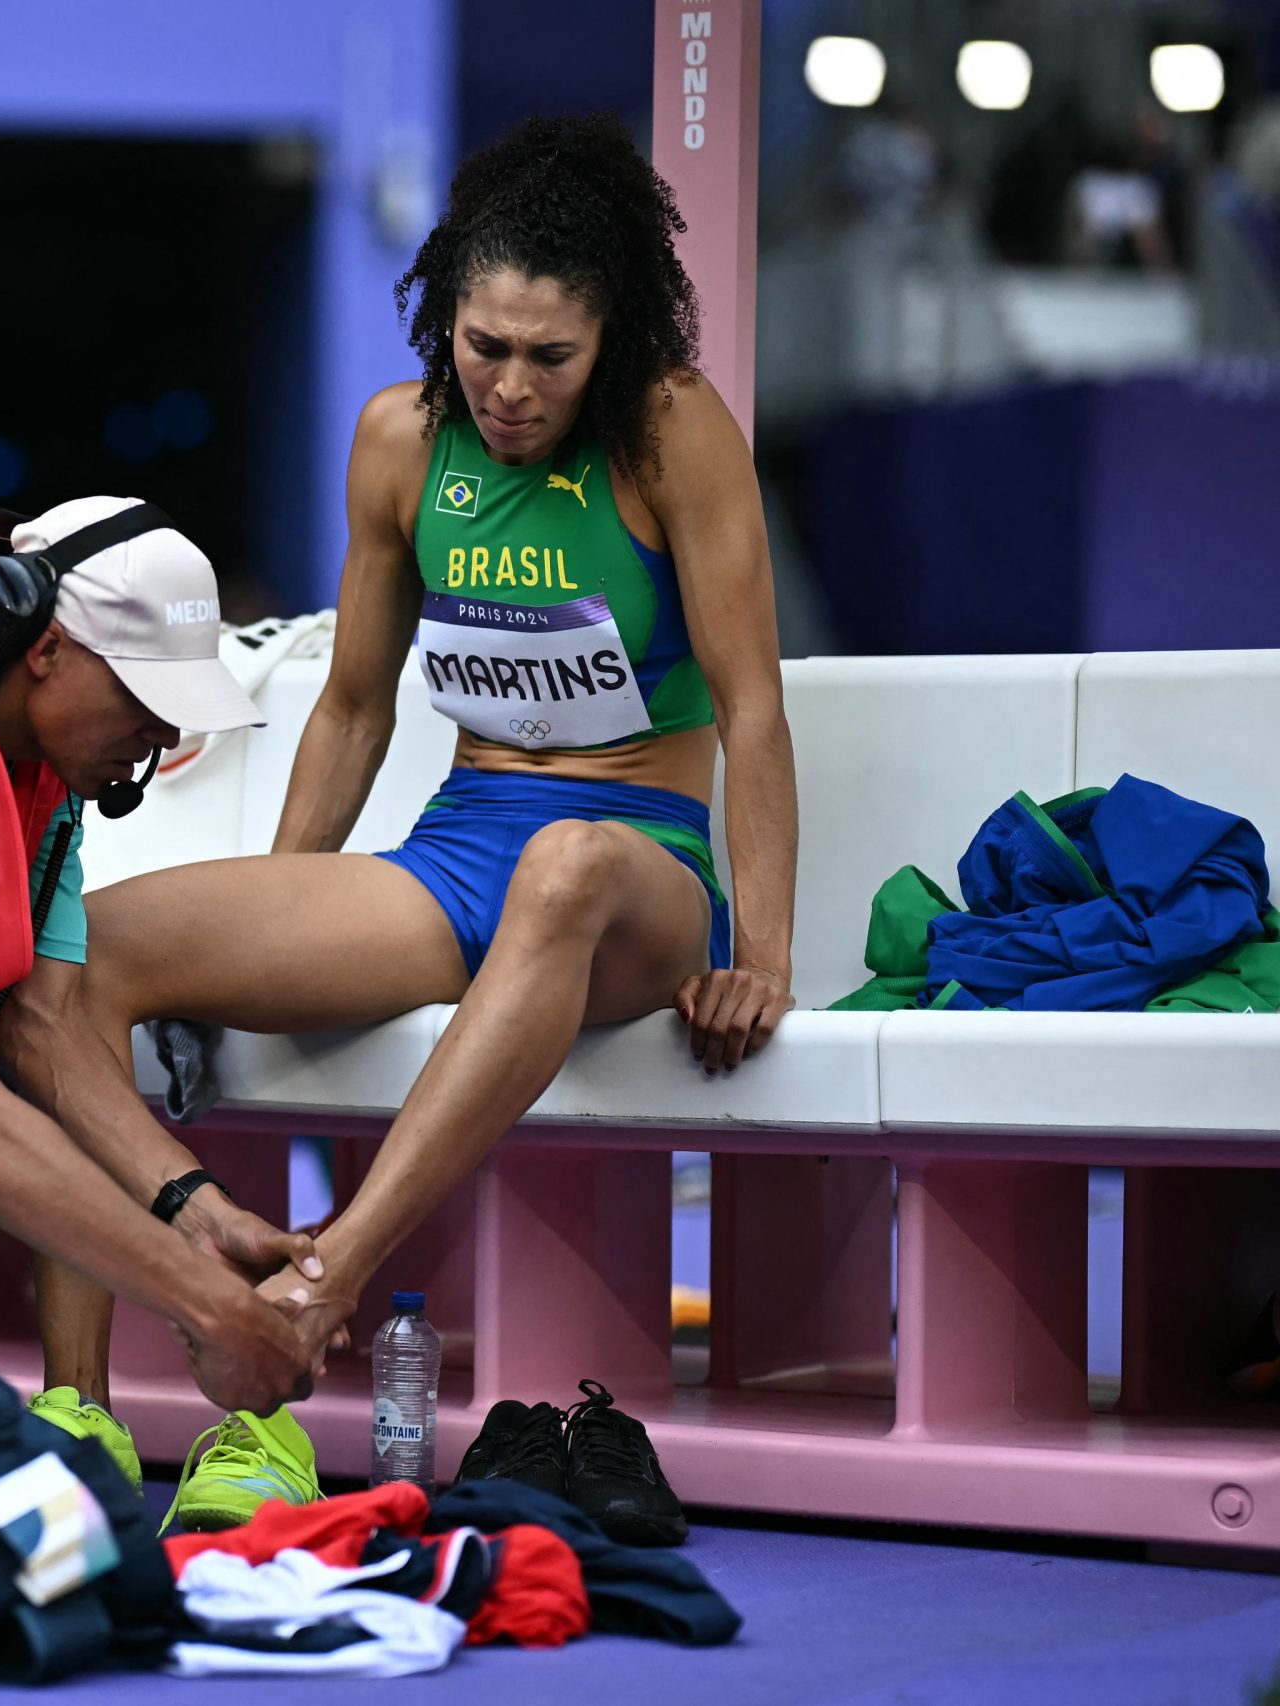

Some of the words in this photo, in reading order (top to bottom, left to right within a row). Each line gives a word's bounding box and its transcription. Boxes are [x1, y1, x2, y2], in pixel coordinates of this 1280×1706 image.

[681, 11, 711, 150] MONDO
[448, 546, 578, 589] BRASIL
[459, 603, 501, 621] PARIS
[506, 610, 548, 625] 2024
[426, 650, 627, 702] MARTINS
